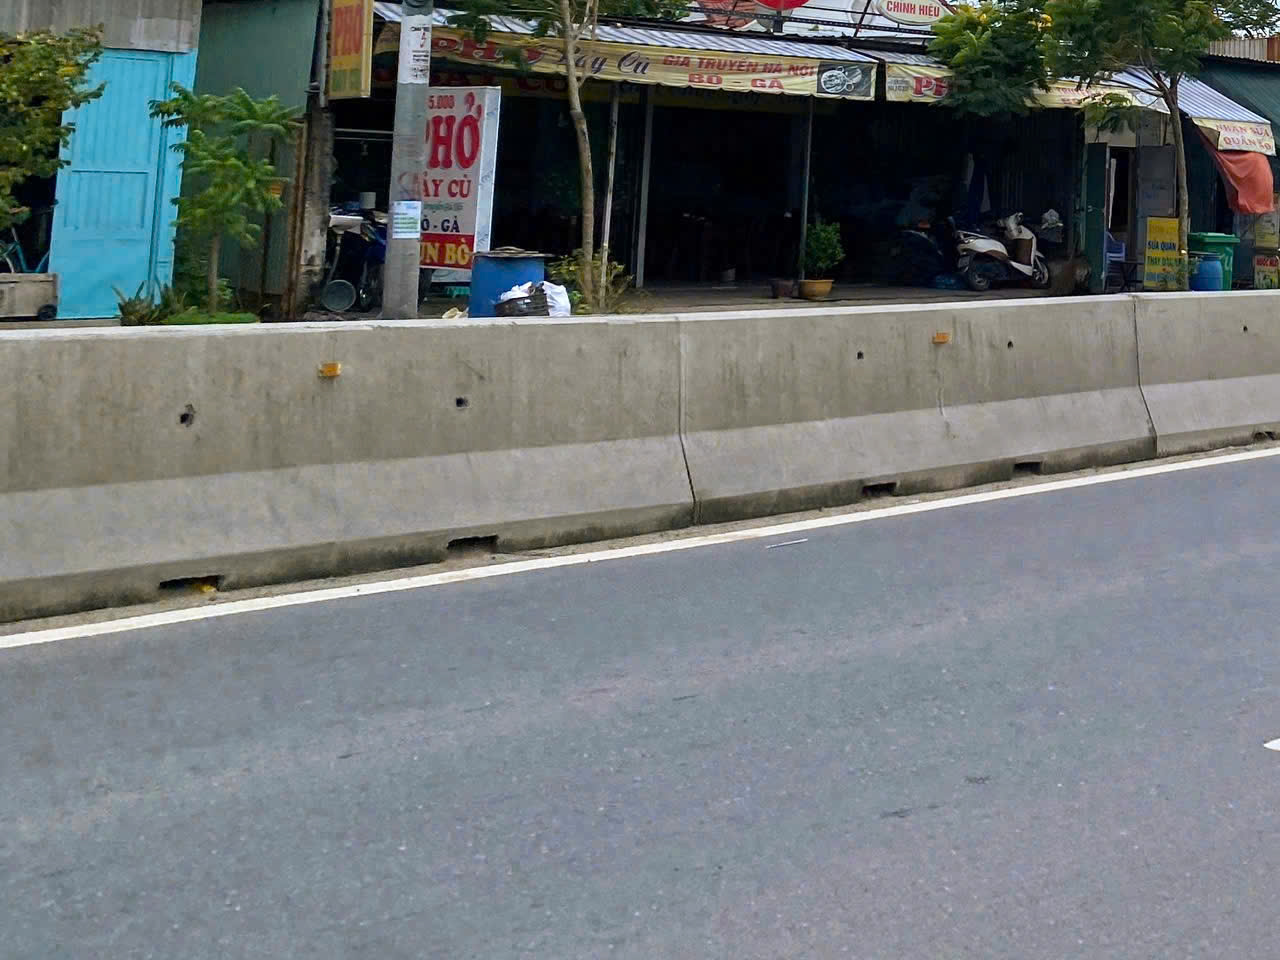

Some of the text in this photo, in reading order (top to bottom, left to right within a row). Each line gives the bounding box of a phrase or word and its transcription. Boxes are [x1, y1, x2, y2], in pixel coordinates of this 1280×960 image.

[662, 54, 690, 69] GIA
[426, 91, 482, 169] HỞ
[422, 171, 444, 198] ẢY
